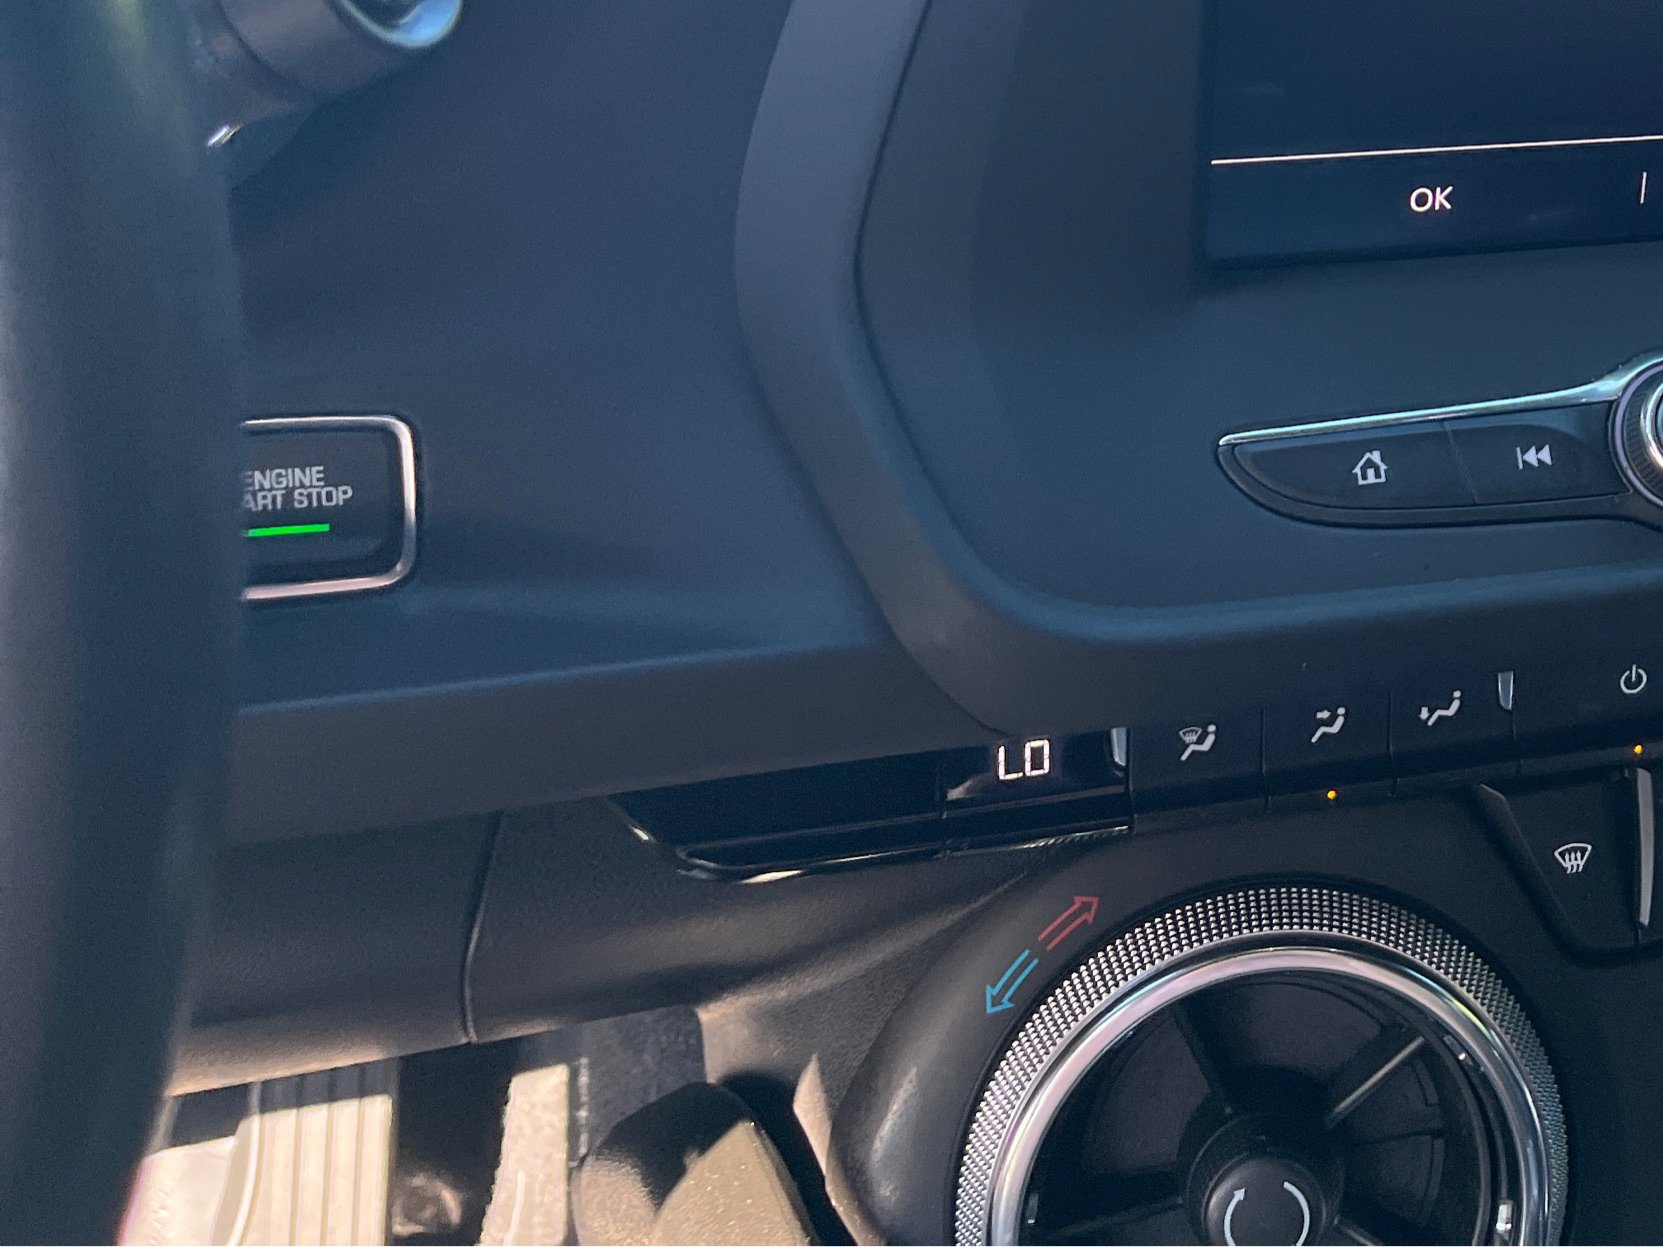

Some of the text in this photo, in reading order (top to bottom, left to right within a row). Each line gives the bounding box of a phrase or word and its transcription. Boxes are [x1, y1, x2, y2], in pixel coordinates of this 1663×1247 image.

[1409, 185, 1454, 213] OK
[243, 485, 354, 512] ART STOP
[997, 739, 1051, 781] LO
